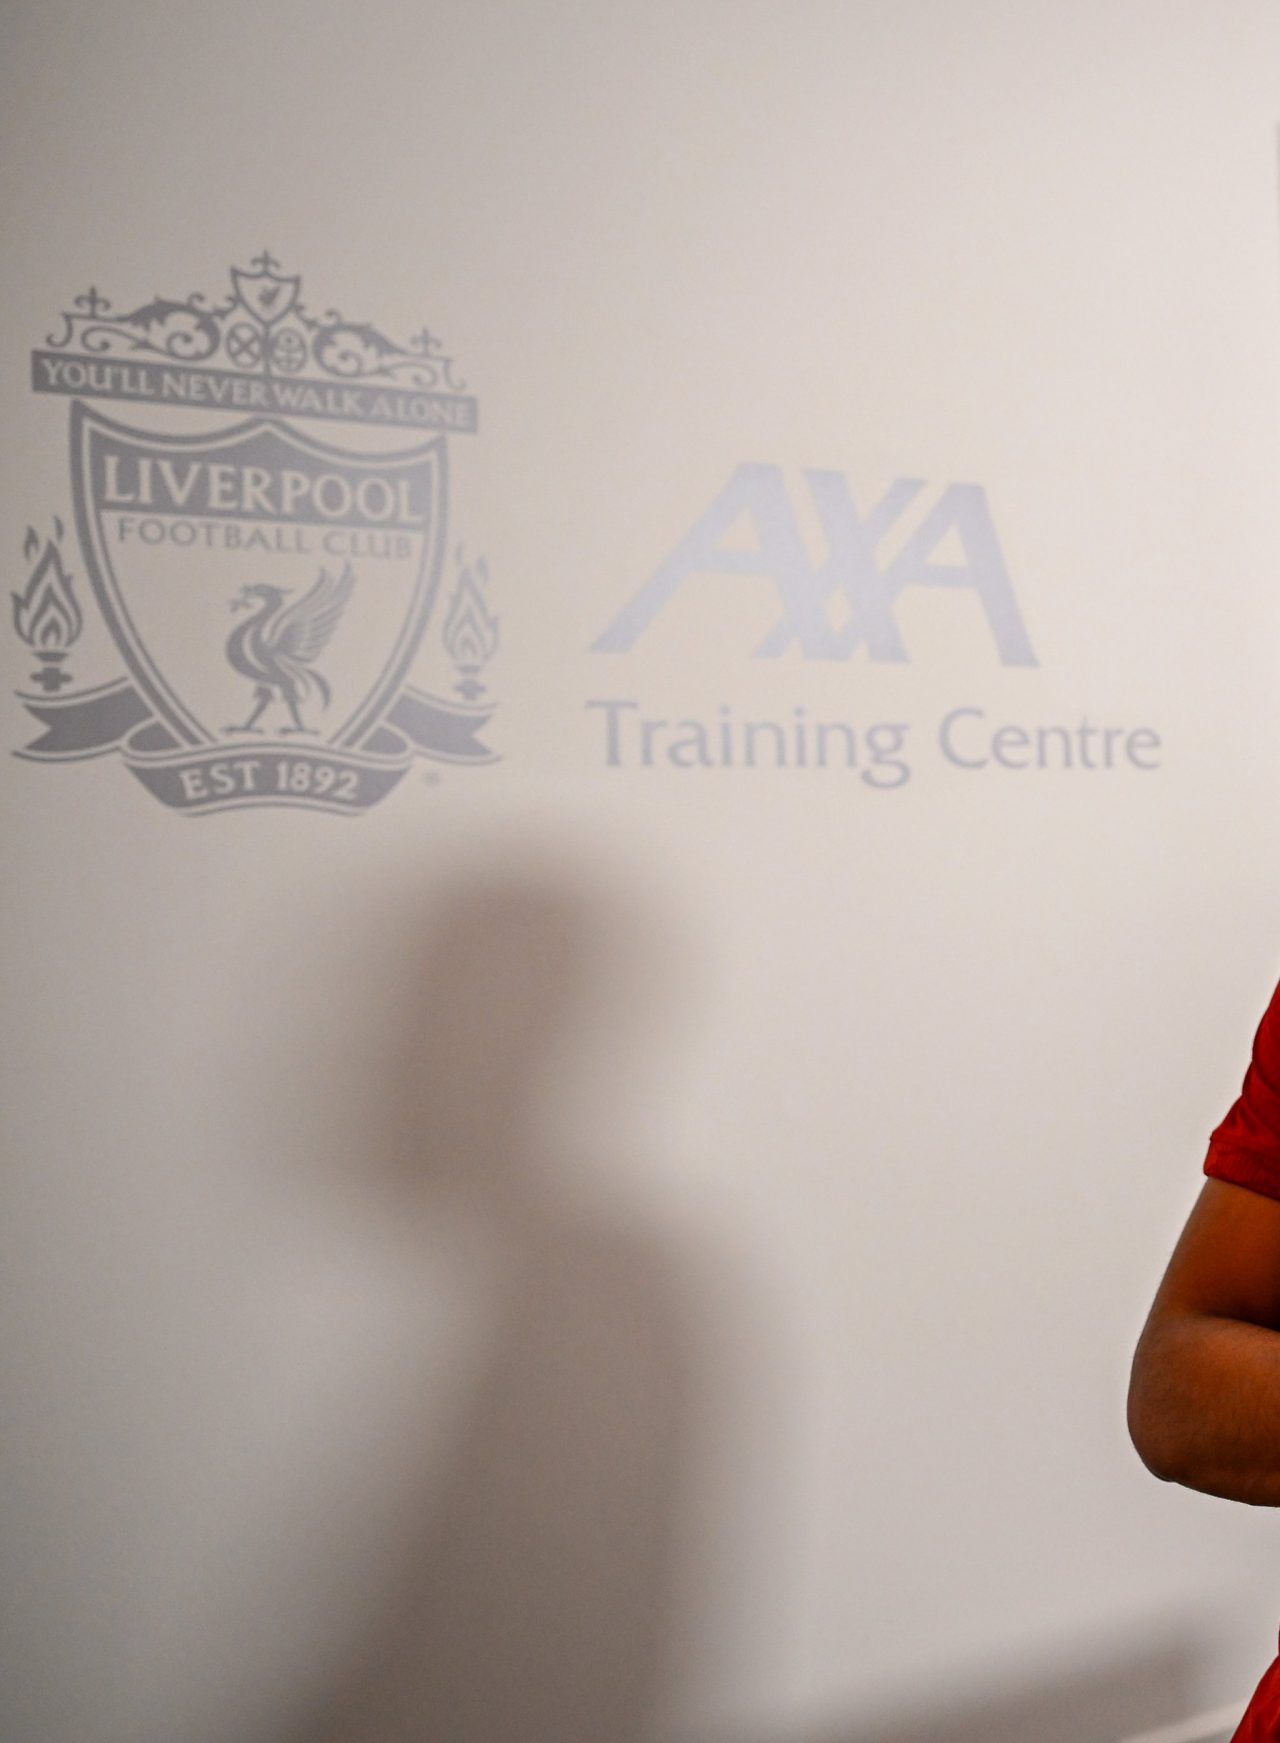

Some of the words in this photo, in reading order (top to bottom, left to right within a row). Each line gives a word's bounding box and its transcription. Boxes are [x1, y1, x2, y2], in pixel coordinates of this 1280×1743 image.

[41, 358, 154, 397] YOU'LL
[162, 369, 267, 408] NEVER
[267, 382, 364, 416] WALK
[372, 394, 472, 427] ALONE
[103, 455, 427, 525] LIVERPOOL
[118, 516, 310, 555] FOOTBALL
[322, 529, 412, 559] CLUB
[587, 462, 1040, 668] AXA
[585, 699, 911, 790] Training
[938, 706, 1163, 770] Centre
[180, 761, 259, 800] EST
[276, 761, 359, 800] 1892
